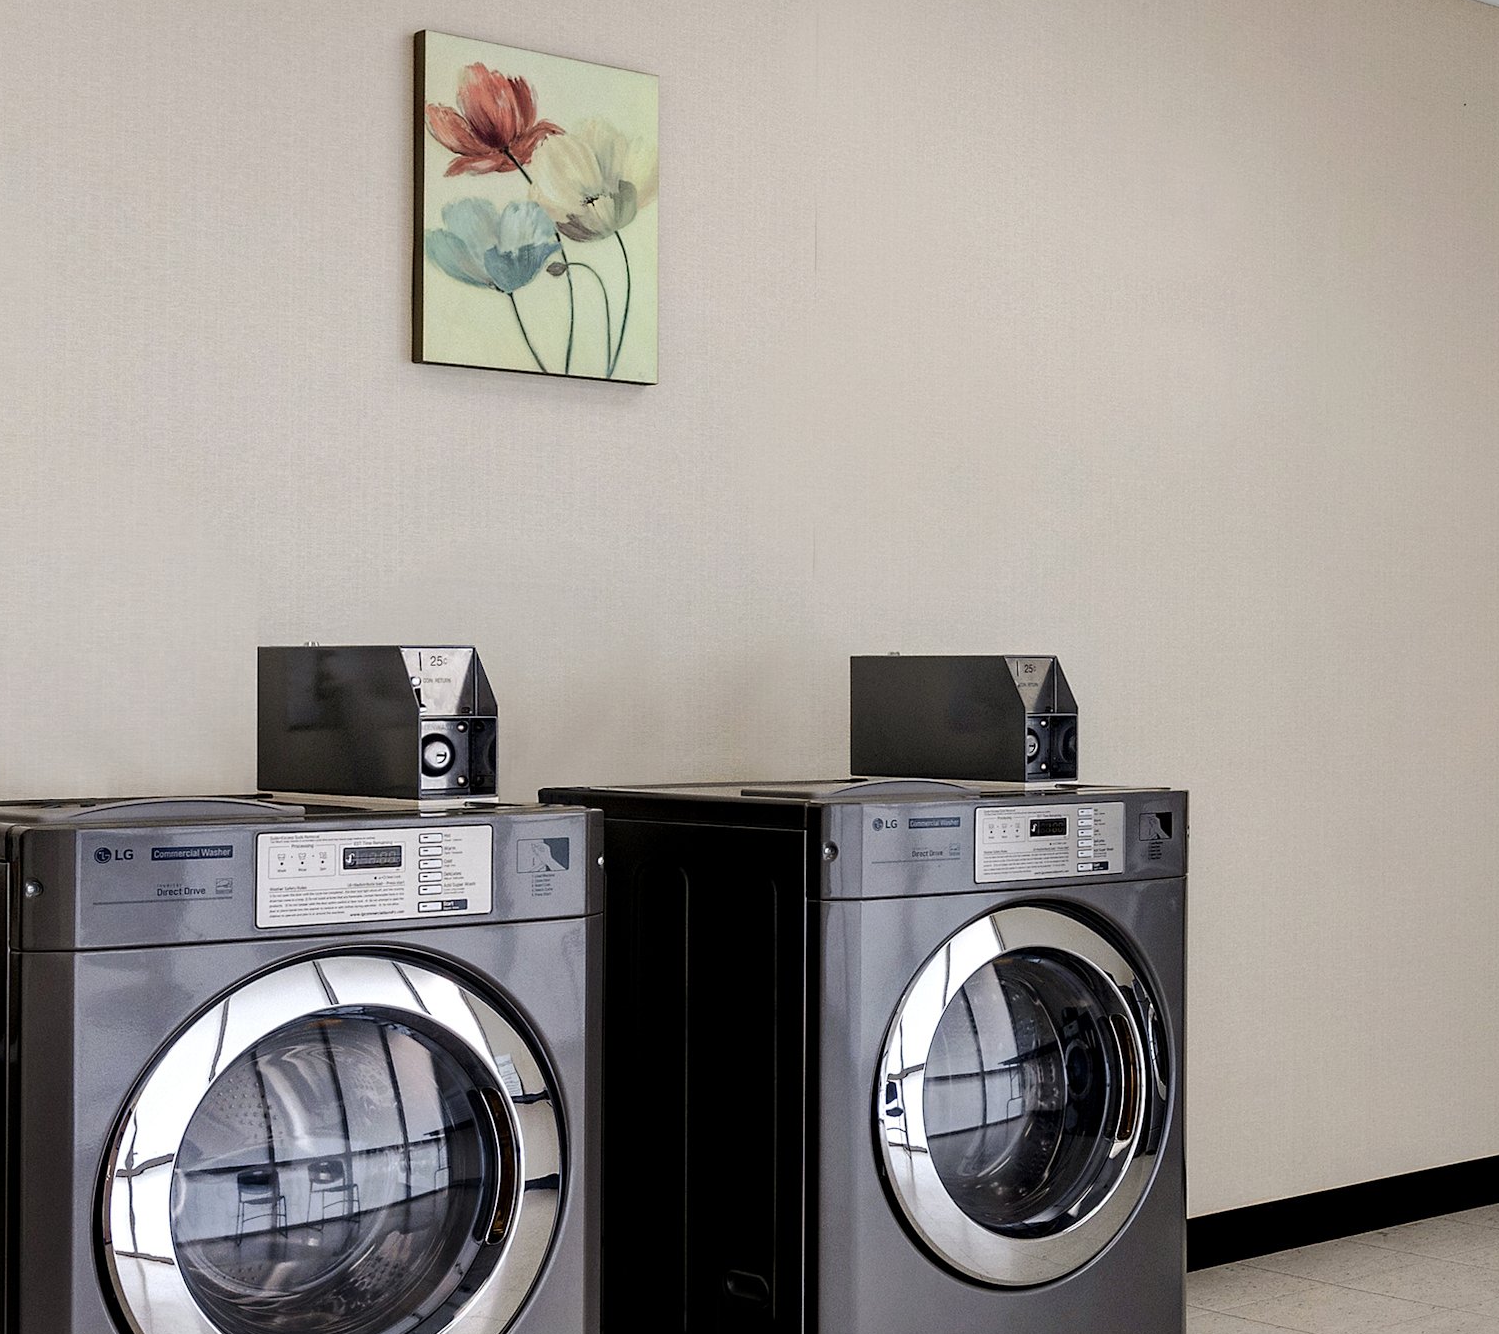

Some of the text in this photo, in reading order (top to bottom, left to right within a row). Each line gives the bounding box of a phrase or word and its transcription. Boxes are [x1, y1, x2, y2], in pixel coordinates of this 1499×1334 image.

[885, 820, 898, 828] LG
[115, 849, 133, 860] LG
[154, 848, 231, 859] Commercial Washer
[157, 887, 206, 896] Direct Drive
